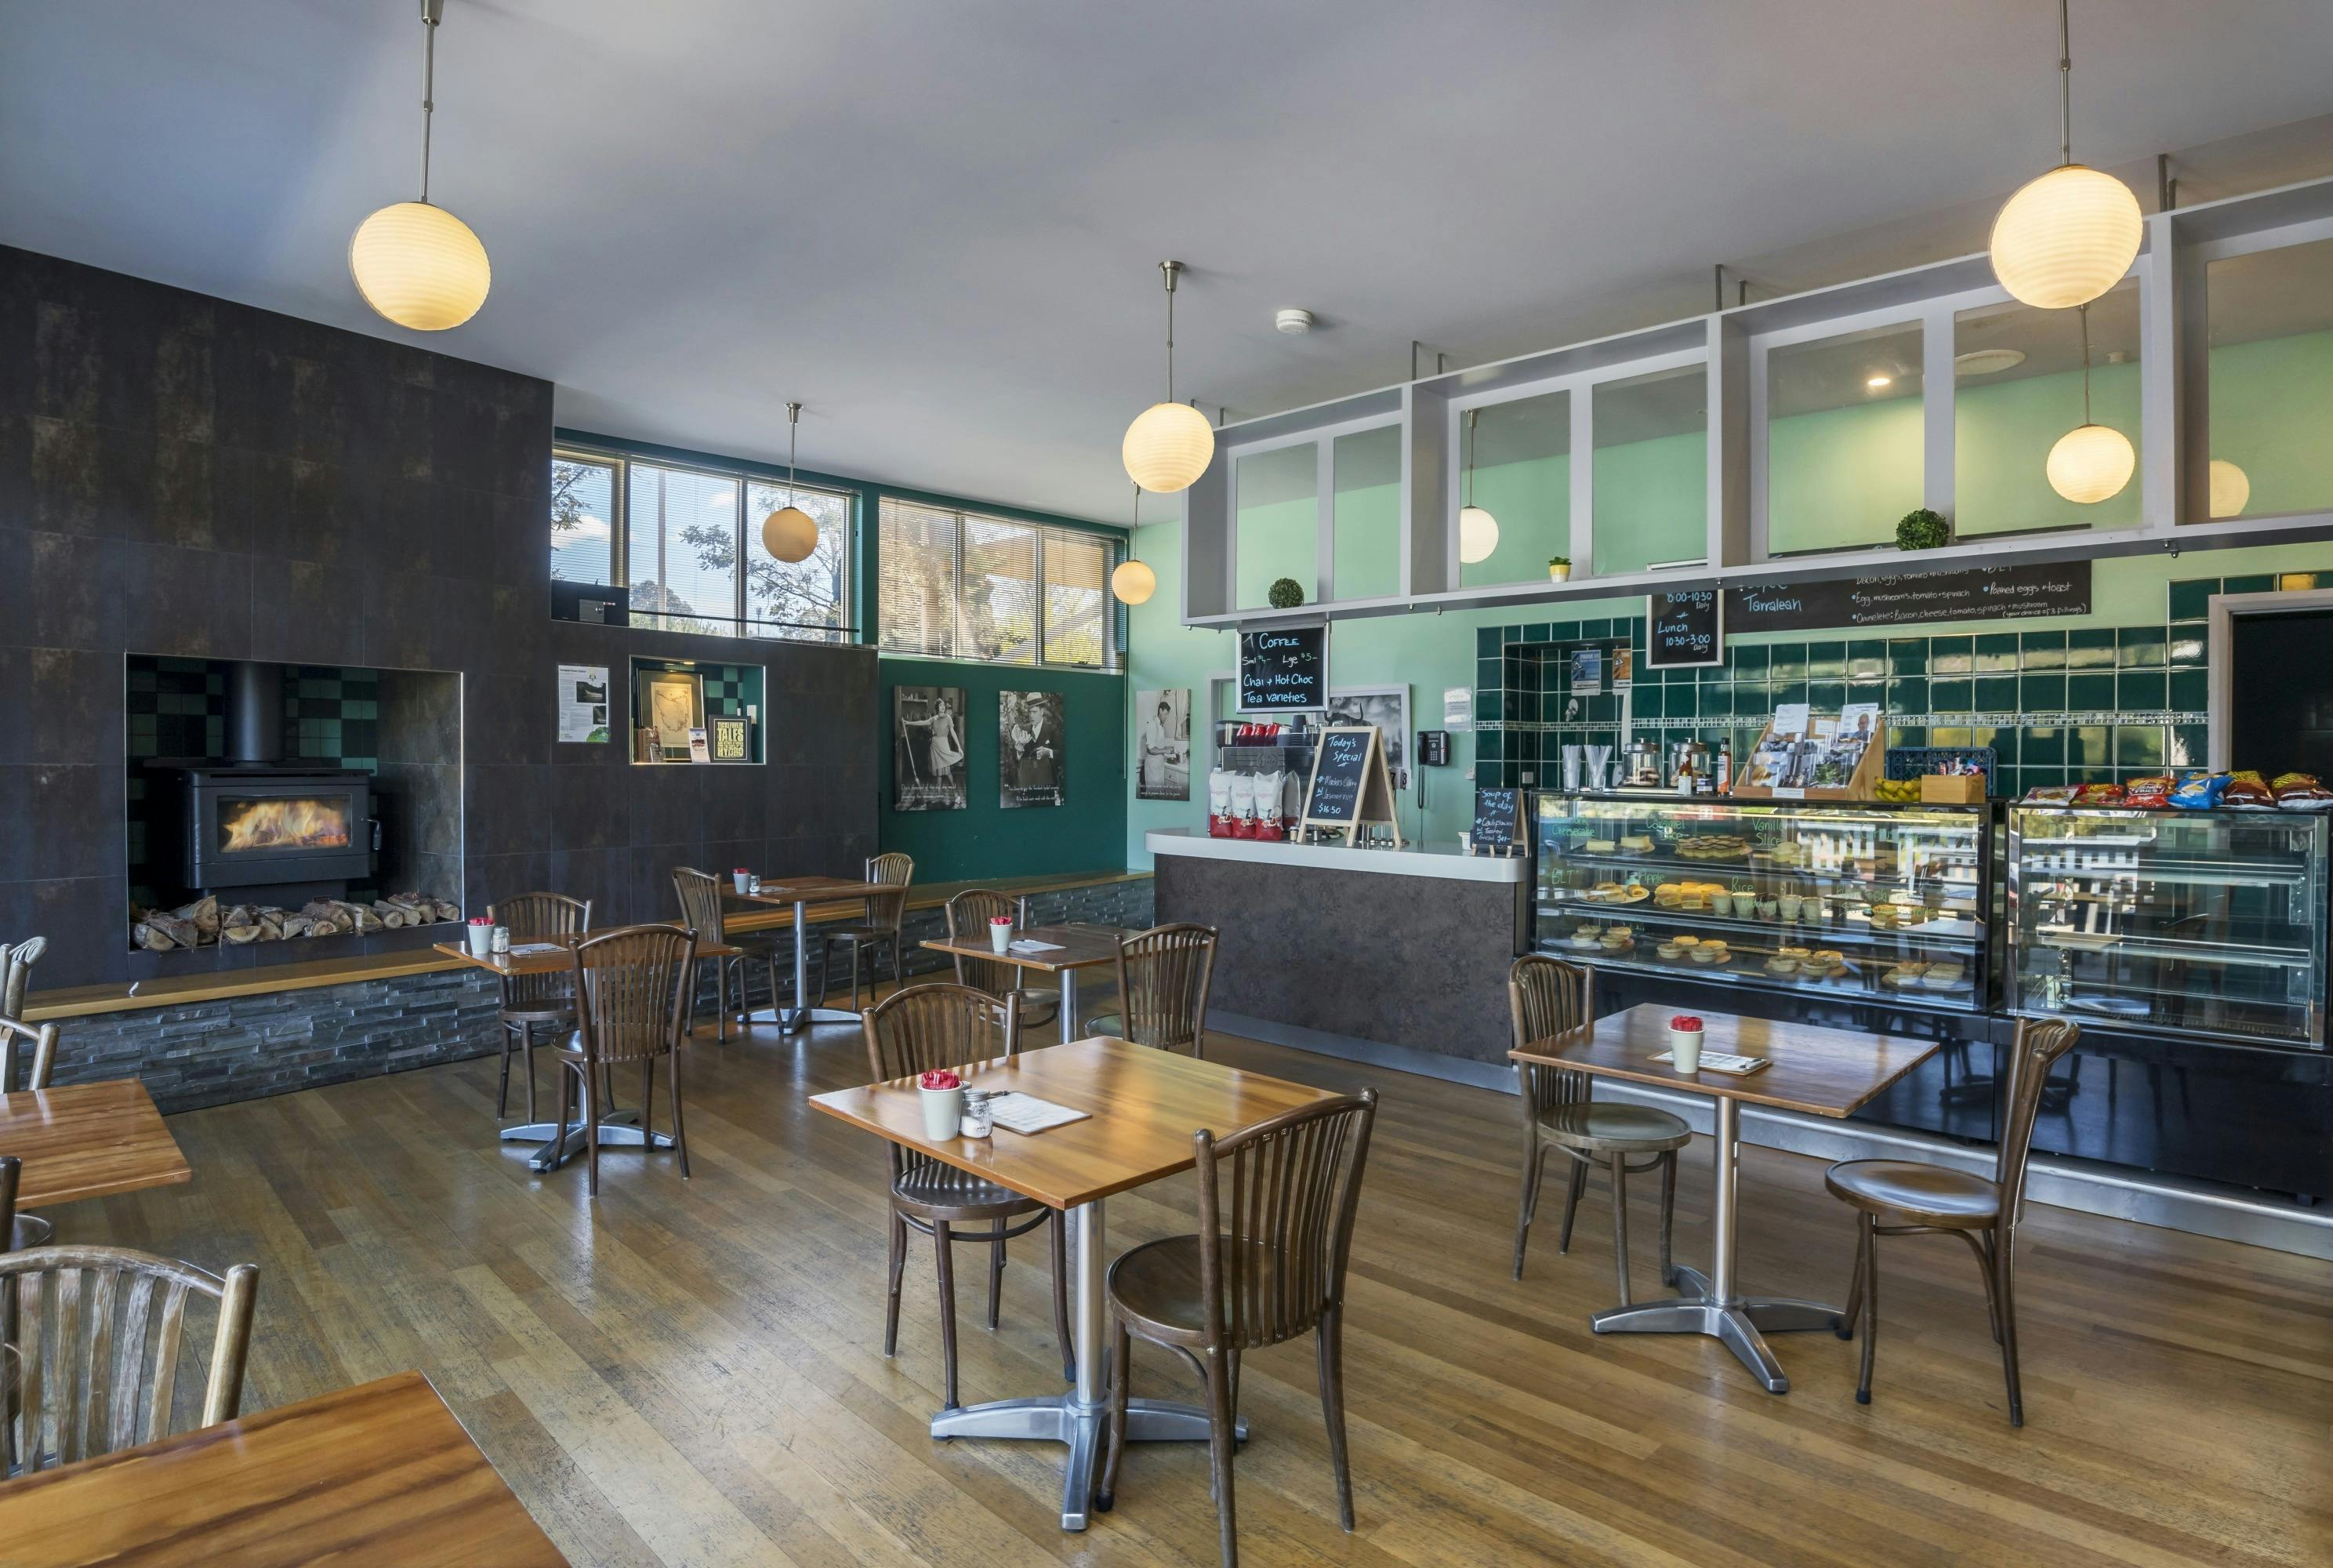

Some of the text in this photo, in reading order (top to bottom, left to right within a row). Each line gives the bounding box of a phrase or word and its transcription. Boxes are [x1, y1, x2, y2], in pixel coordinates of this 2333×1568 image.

[2017, 586, 2040, 596] eggs
[1696, 601, 1710, 612] Daily
[1743, 593, 1801, 612] Tarraleah
[1658, 621, 1688, 634] Lunch
[1693, 644, 1708, 654] Daily
[1283, 655, 1298, 667] Lge
[1243, 673, 1264, 687] Chai
[1275, 674, 1290, 685] Hot
[1291, 673, 1314, 684] Choc
[1243, 691, 1263, 703] Tea
[1328, 735, 1356, 752] Today's
[1333, 751, 1362, 762] Special
[1482, 789, 1512, 802] Soup of
[1483, 799, 1514, 814] the day
[1756, 832, 1781, 847] Slice
[1731, 876, 1754, 892] Rice
